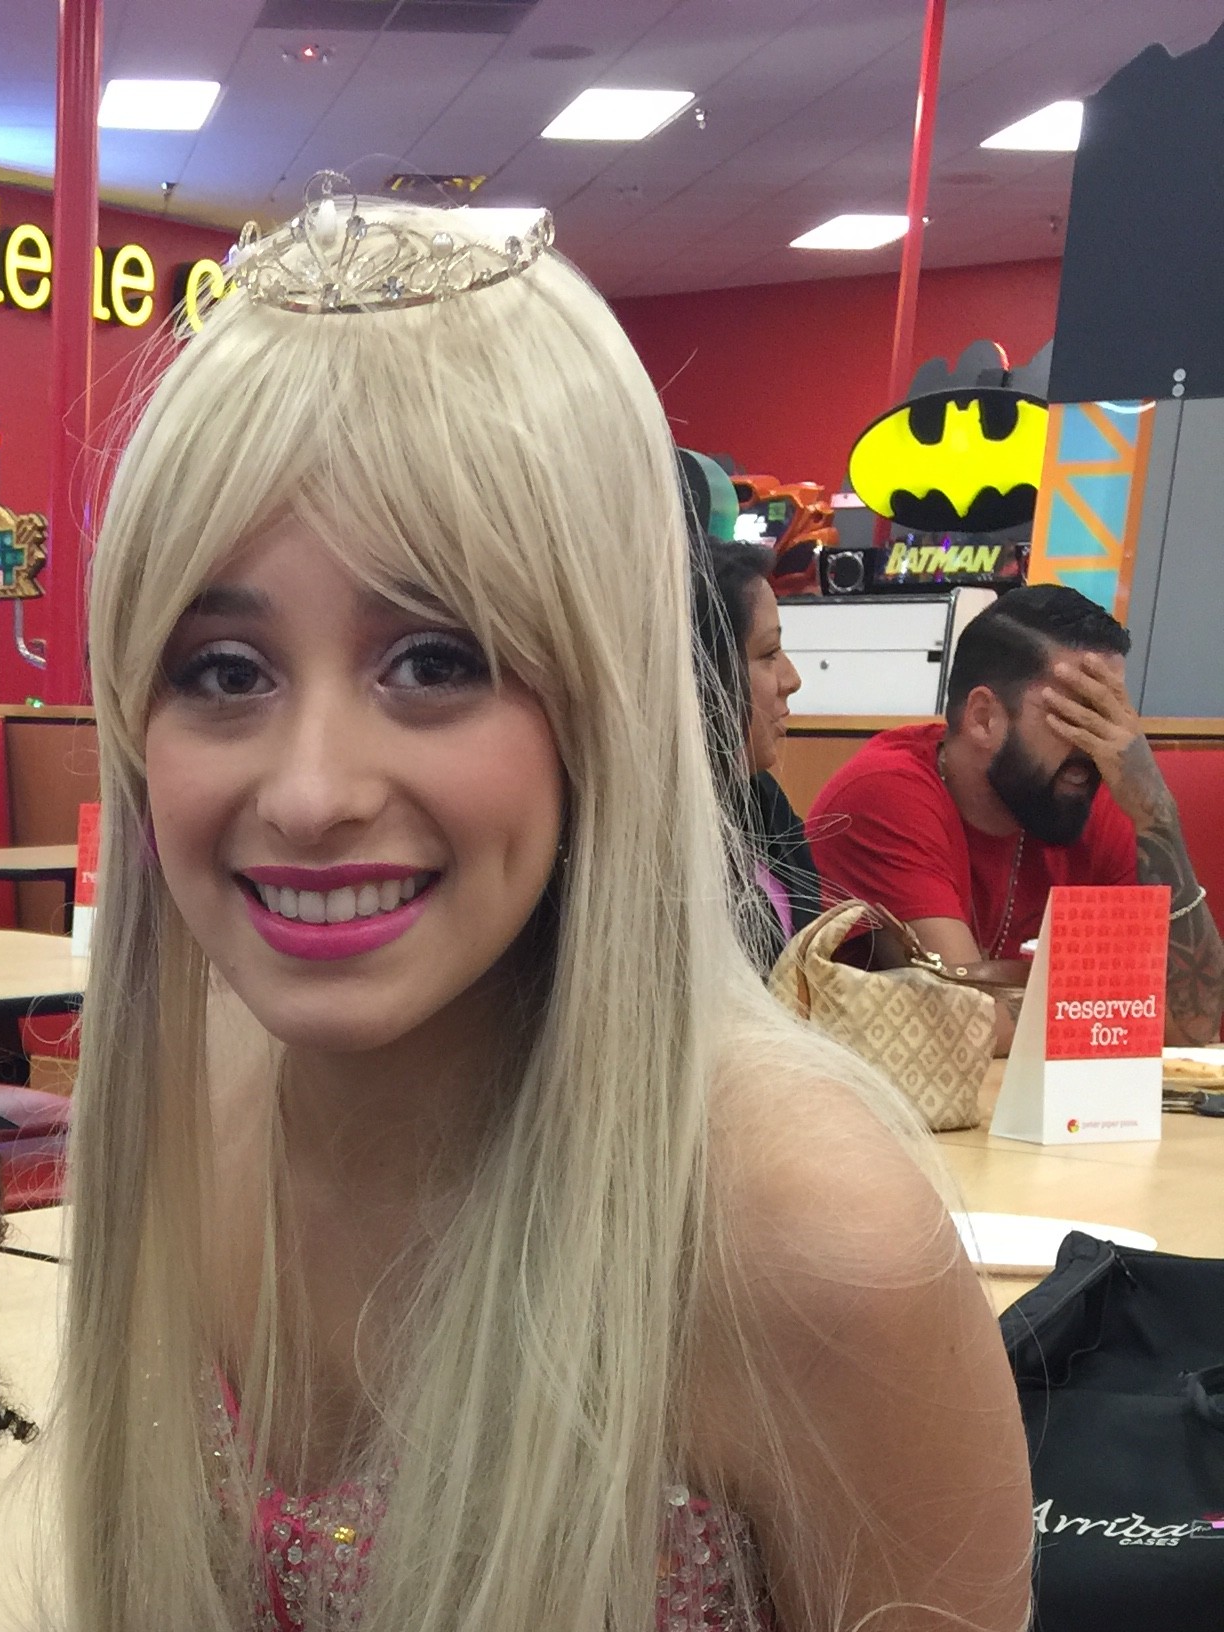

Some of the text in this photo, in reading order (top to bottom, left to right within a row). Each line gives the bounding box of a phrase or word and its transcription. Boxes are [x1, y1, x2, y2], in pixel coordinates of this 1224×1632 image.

[1055, 995, 1156, 1020] reserved
[1090, 1022, 1128, 1046] for:
[1032, 1499, 1194, 1538] Arriba
[1119, 1537, 1181, 1547] CASES
